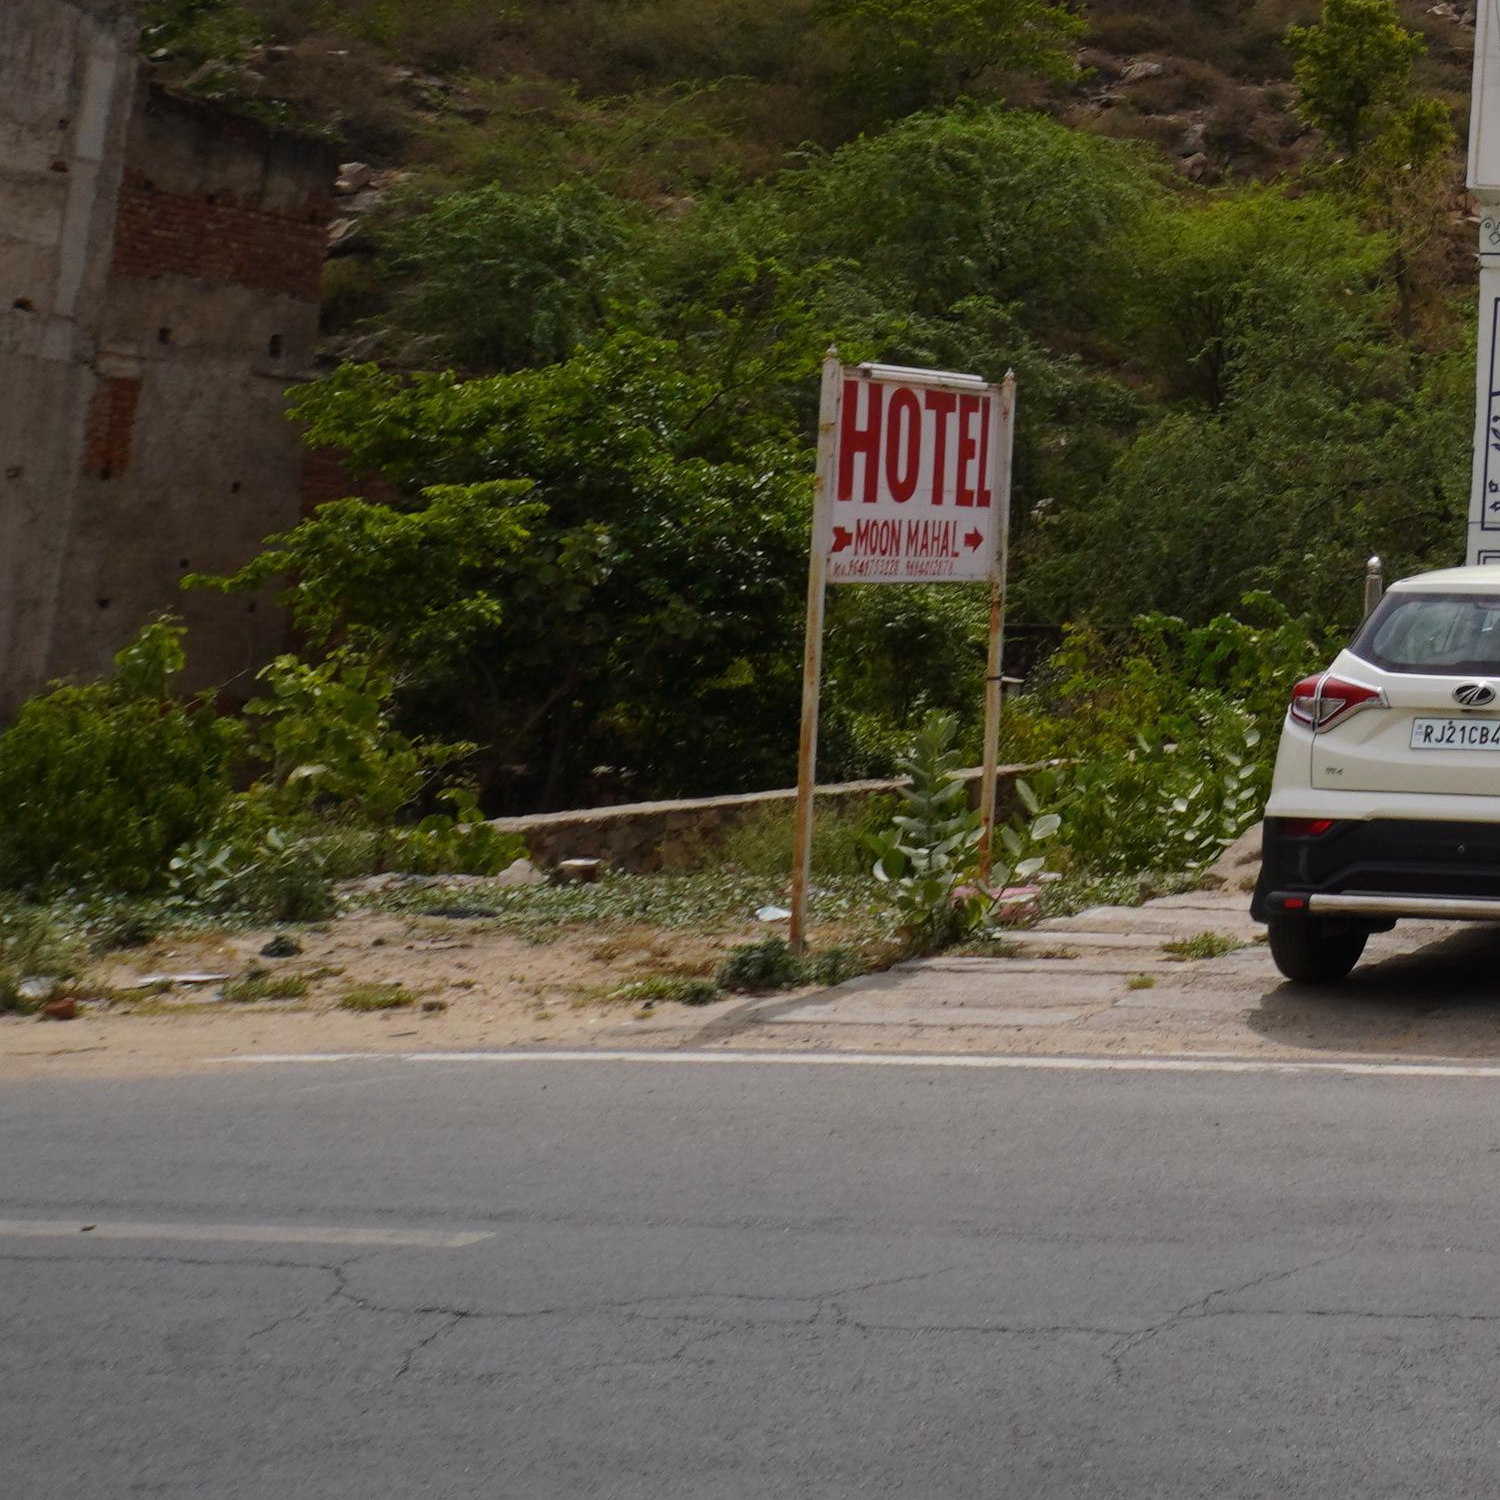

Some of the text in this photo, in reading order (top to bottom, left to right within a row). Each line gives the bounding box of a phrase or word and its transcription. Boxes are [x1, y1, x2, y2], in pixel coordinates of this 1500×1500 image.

[837, 379, 992, 508] HOTEL
[853, 519, 959, 558] MOON MAHAL
